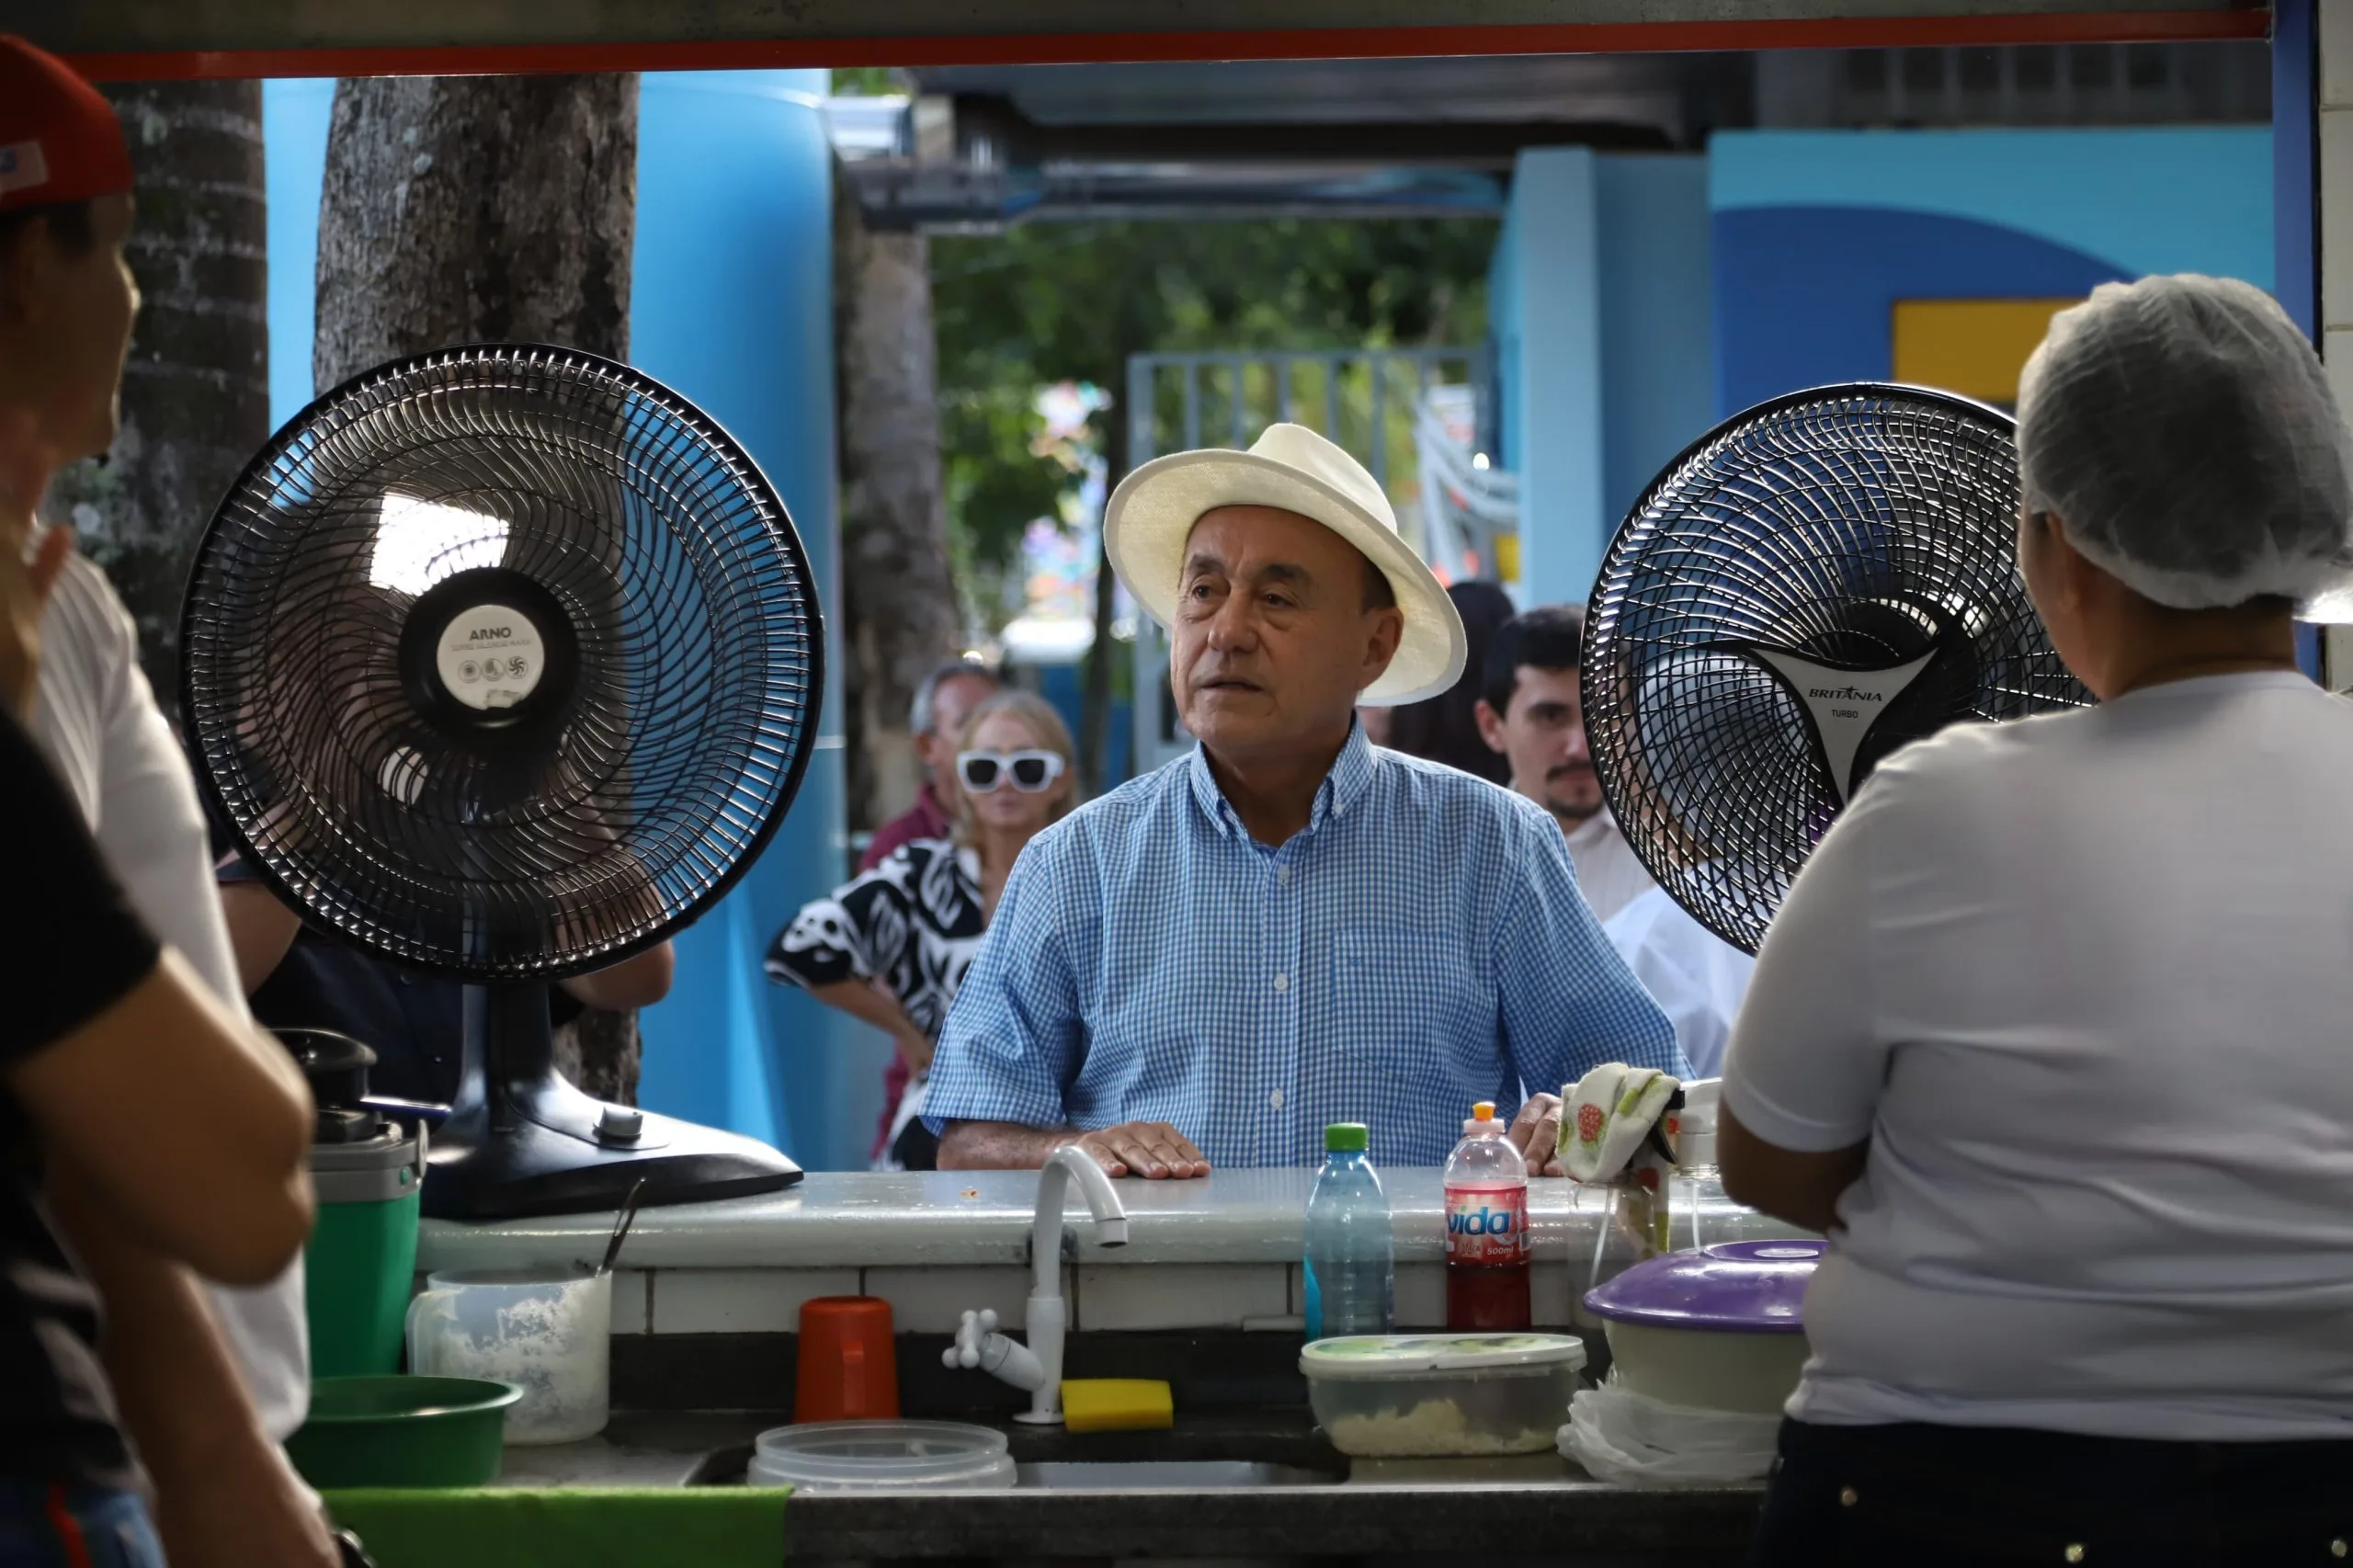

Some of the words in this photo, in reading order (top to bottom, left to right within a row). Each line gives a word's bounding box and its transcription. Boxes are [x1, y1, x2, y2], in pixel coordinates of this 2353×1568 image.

[470, 627, 512, 642] ARNO
[1832, 710, 1859, 718] TURBO
[1447, 1206, 1510, 1236] vida
